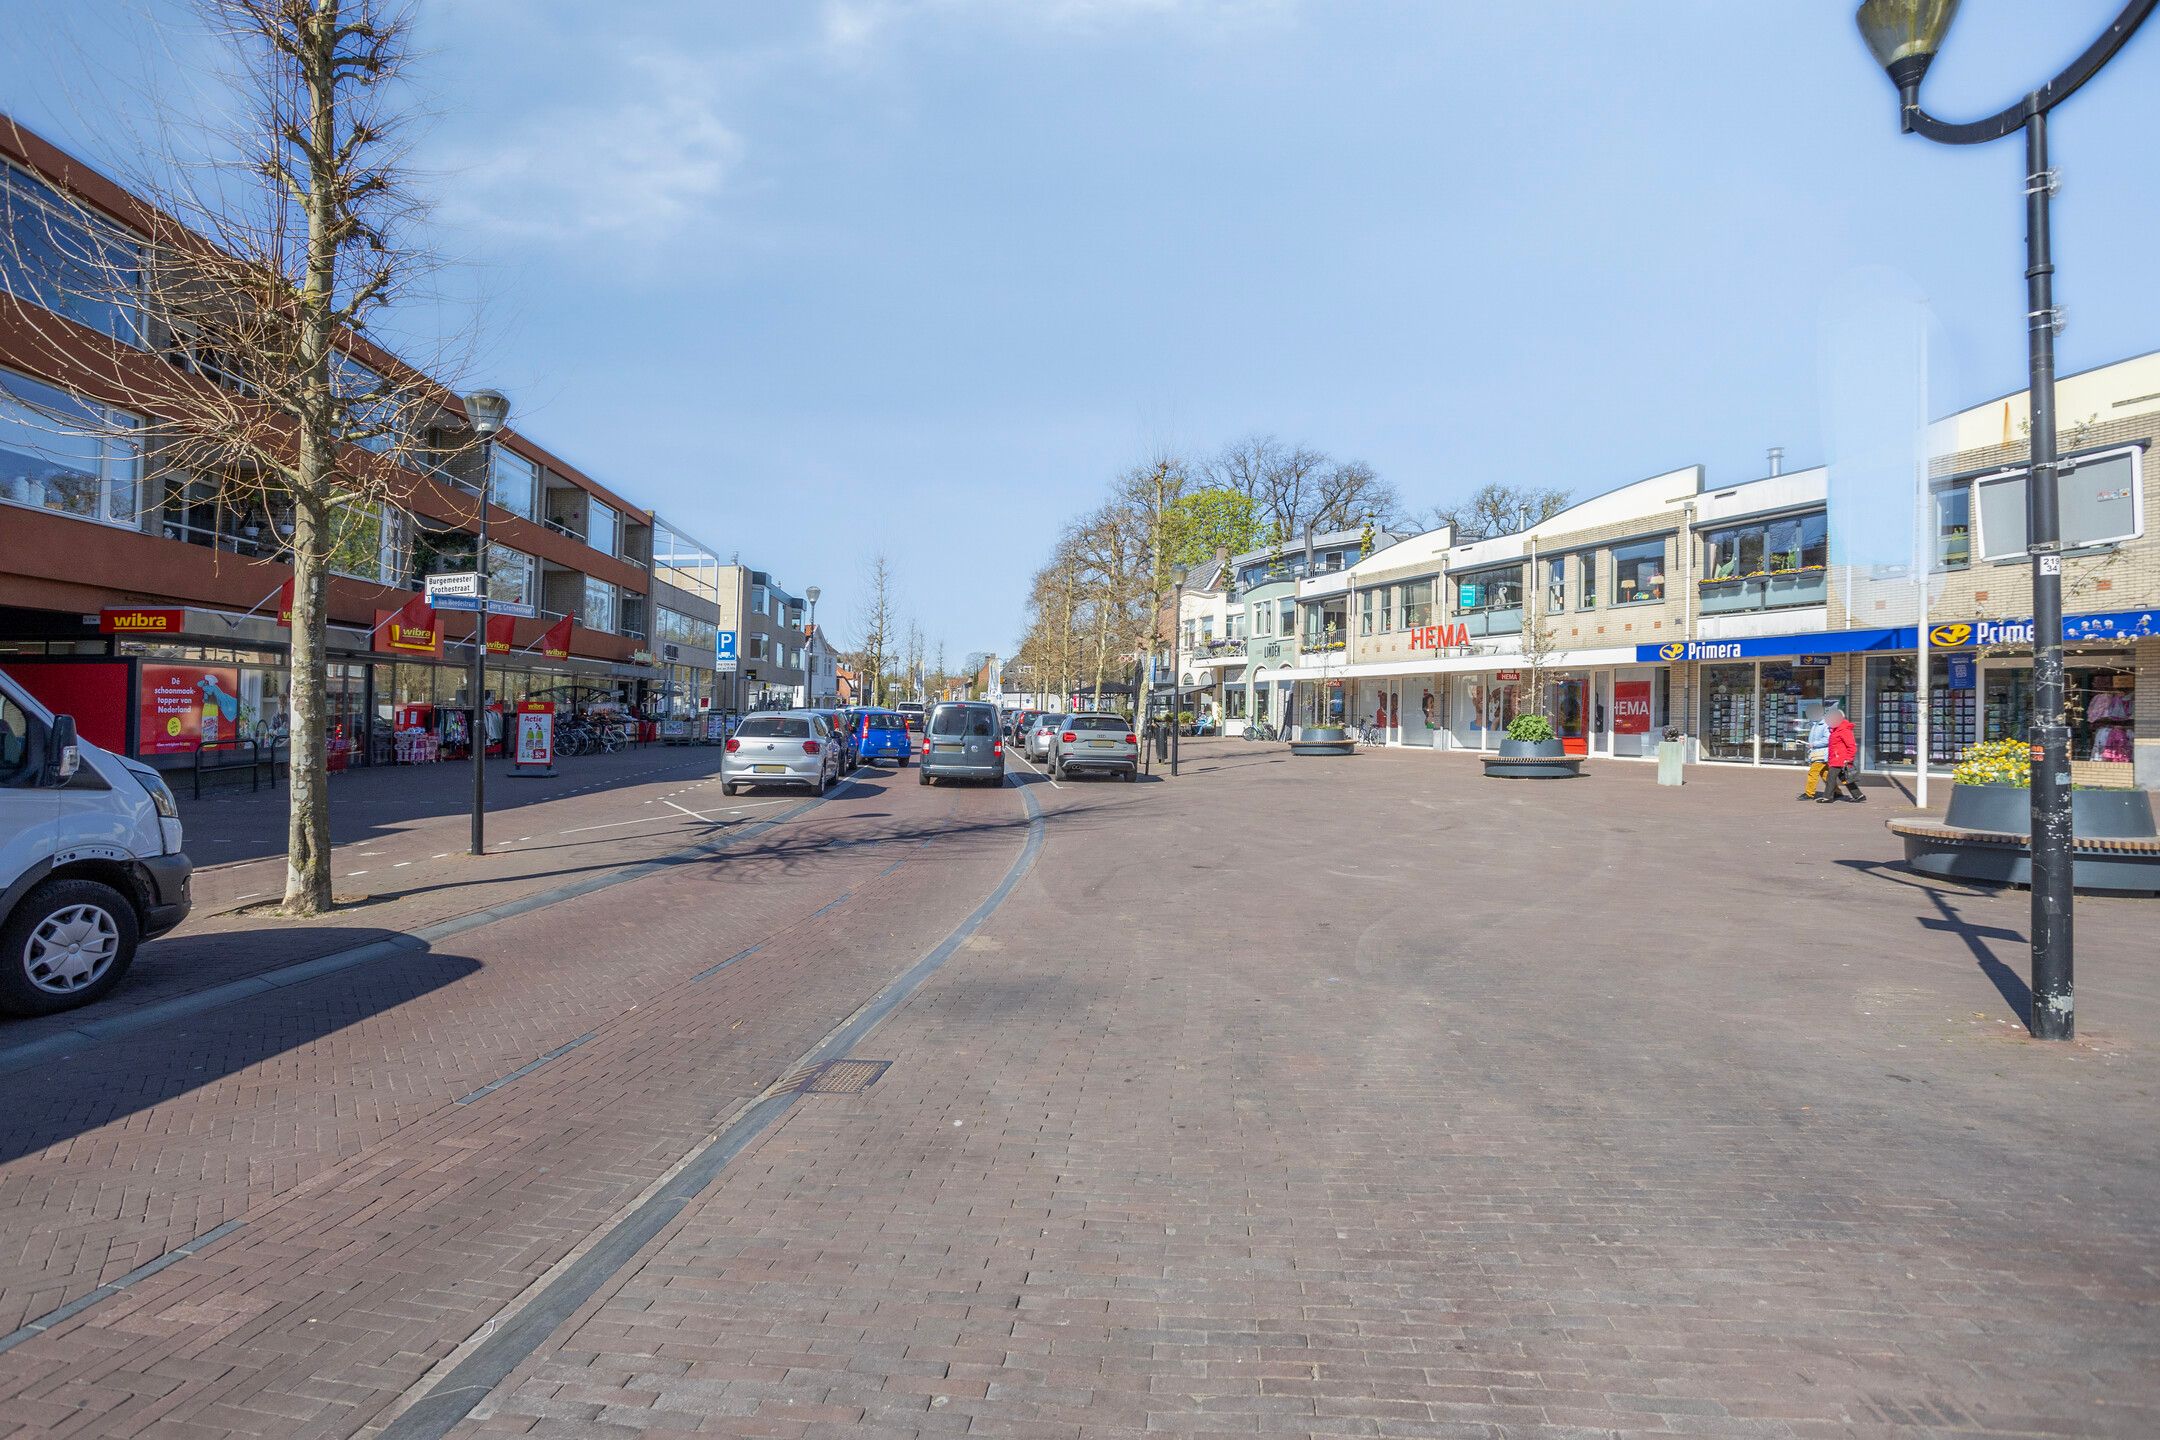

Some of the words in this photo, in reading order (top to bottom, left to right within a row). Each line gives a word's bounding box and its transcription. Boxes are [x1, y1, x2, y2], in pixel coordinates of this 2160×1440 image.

[429, 576, 473, 586] Burgemeester
[431, 585, 470, 593] Grothestraat
[114, 613, 167, 627] wibra
[402, 627, 431, 637] wibra
[1410, 623, 1470, 650] HEMA
[1977, 622, 2035, 644] Prime
[486, 641, 510, 650] wibra
[721, 633, 733, 649] P
[545, 648, 567, 657] wibra
[1264, 645, 1281, 658] LINDEN
[1688, 642, 1742, 660] Primera
[171, 677, 180, 685] Dé
[158, 697, 179, 705] topper
